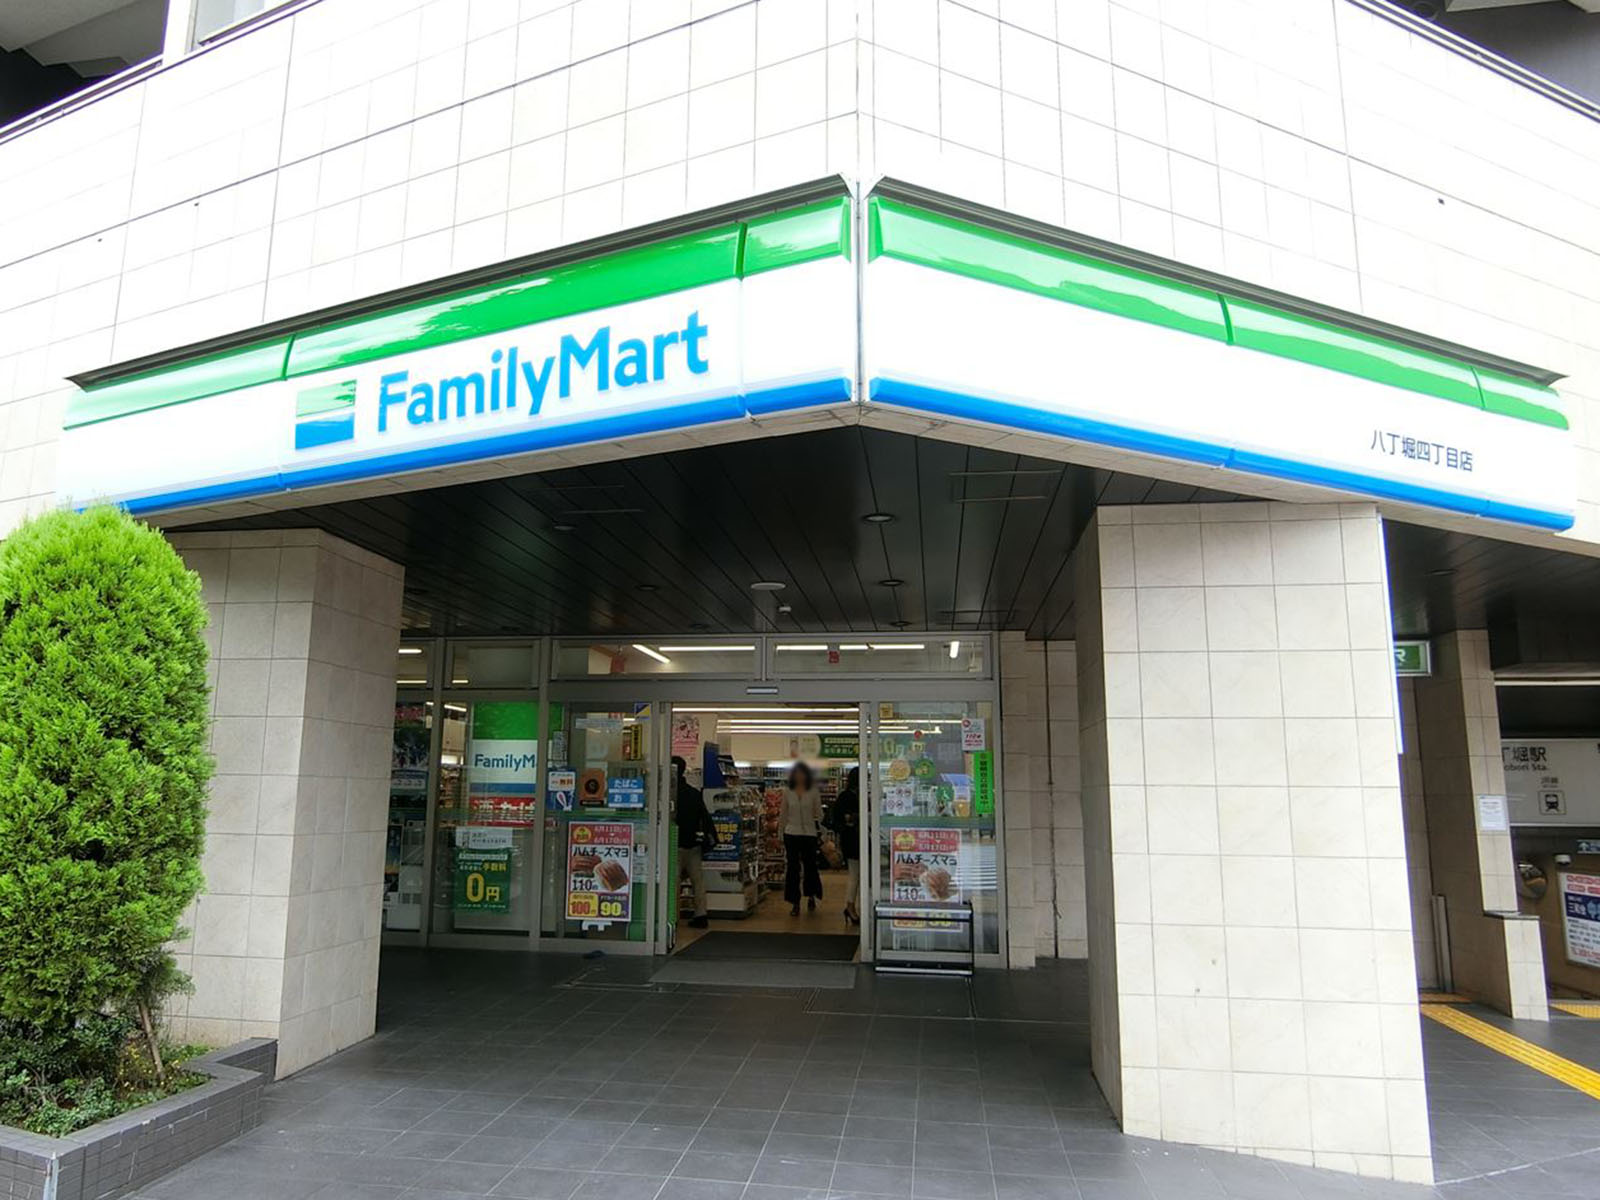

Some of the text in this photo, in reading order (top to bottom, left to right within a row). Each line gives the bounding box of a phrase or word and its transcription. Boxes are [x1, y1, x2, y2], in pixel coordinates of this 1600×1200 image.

[378, 310, 709, 433] FamilyMart
[1370, 429, 1473, 472] 八丁堀四丁目店
[474, 753, 536, 772] FamilyM
[614, 779, 638, 789] たばこ
[573, 846, 629, 857] ハムチーズマヨ
